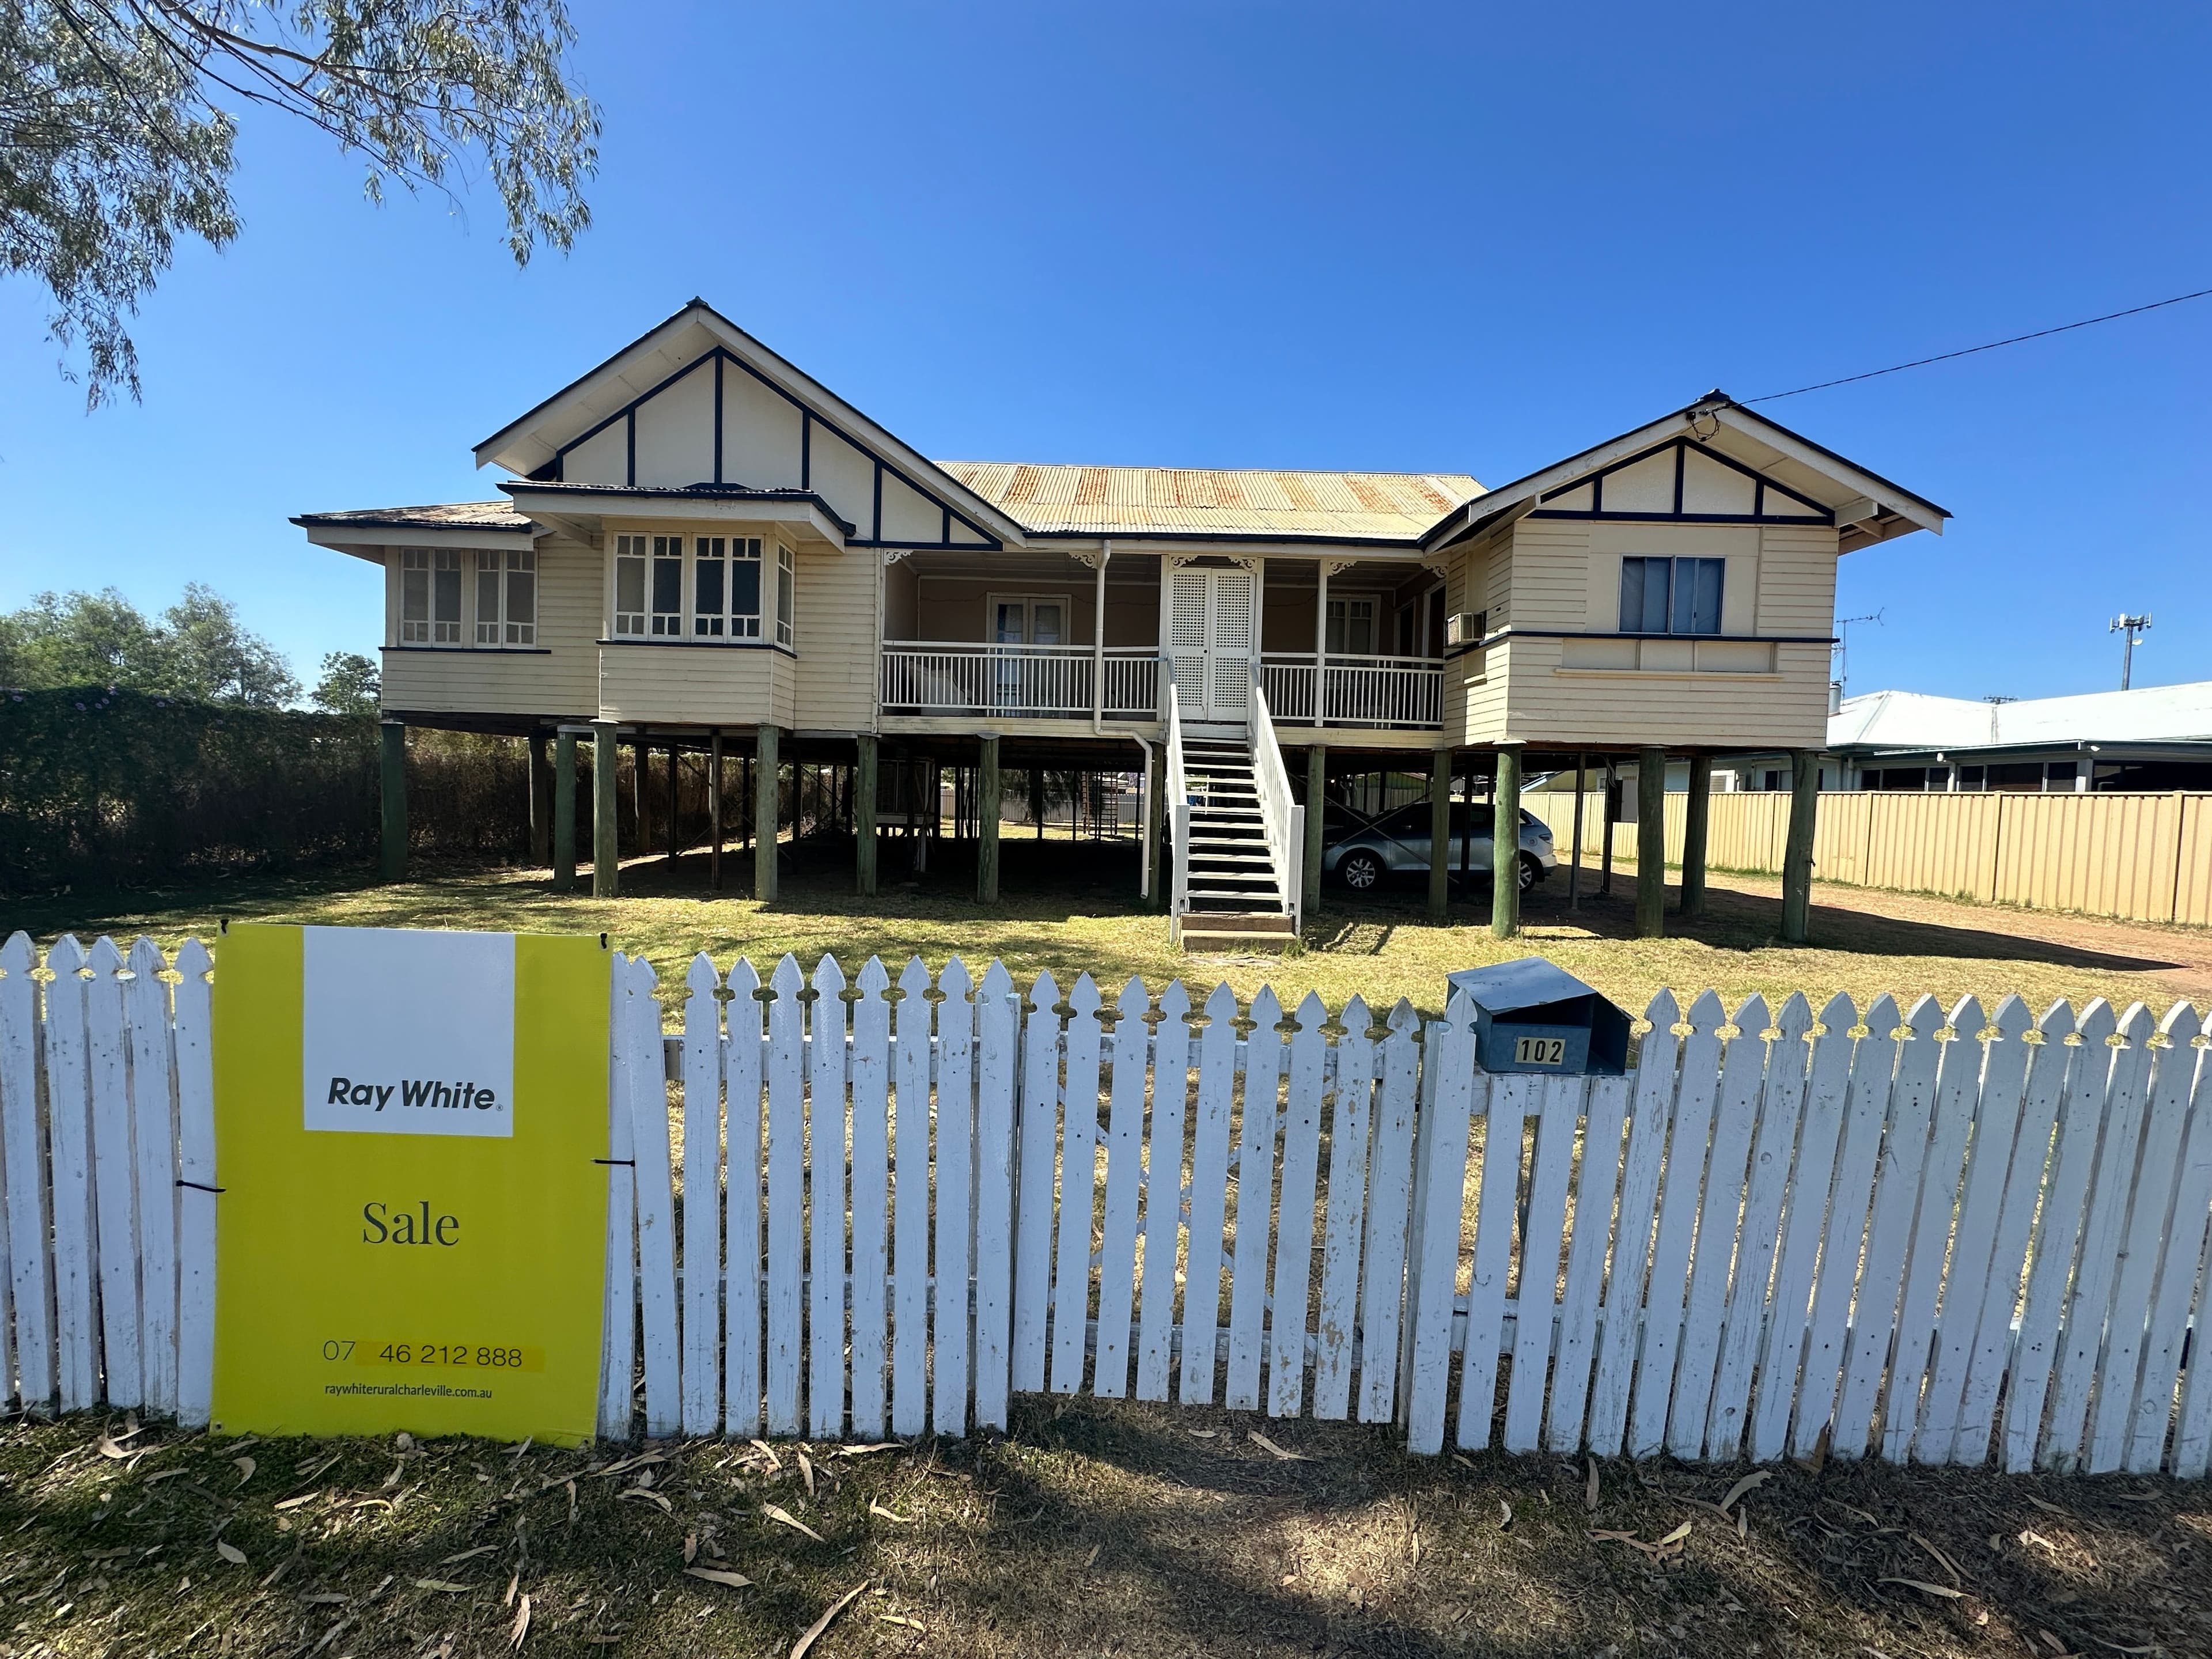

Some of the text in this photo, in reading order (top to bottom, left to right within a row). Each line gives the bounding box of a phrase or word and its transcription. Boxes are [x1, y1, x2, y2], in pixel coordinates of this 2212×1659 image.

[1521, 1040, 1562, 1062] 102
[328, 1077, 495, 1112] Ray White
[363, 1201, 459, 1246] Sale
[323, 1340, 522, 1367] 07 46 212 888
[325, 1383, 492, 1399] raywhiteruralcharleville.com.au
